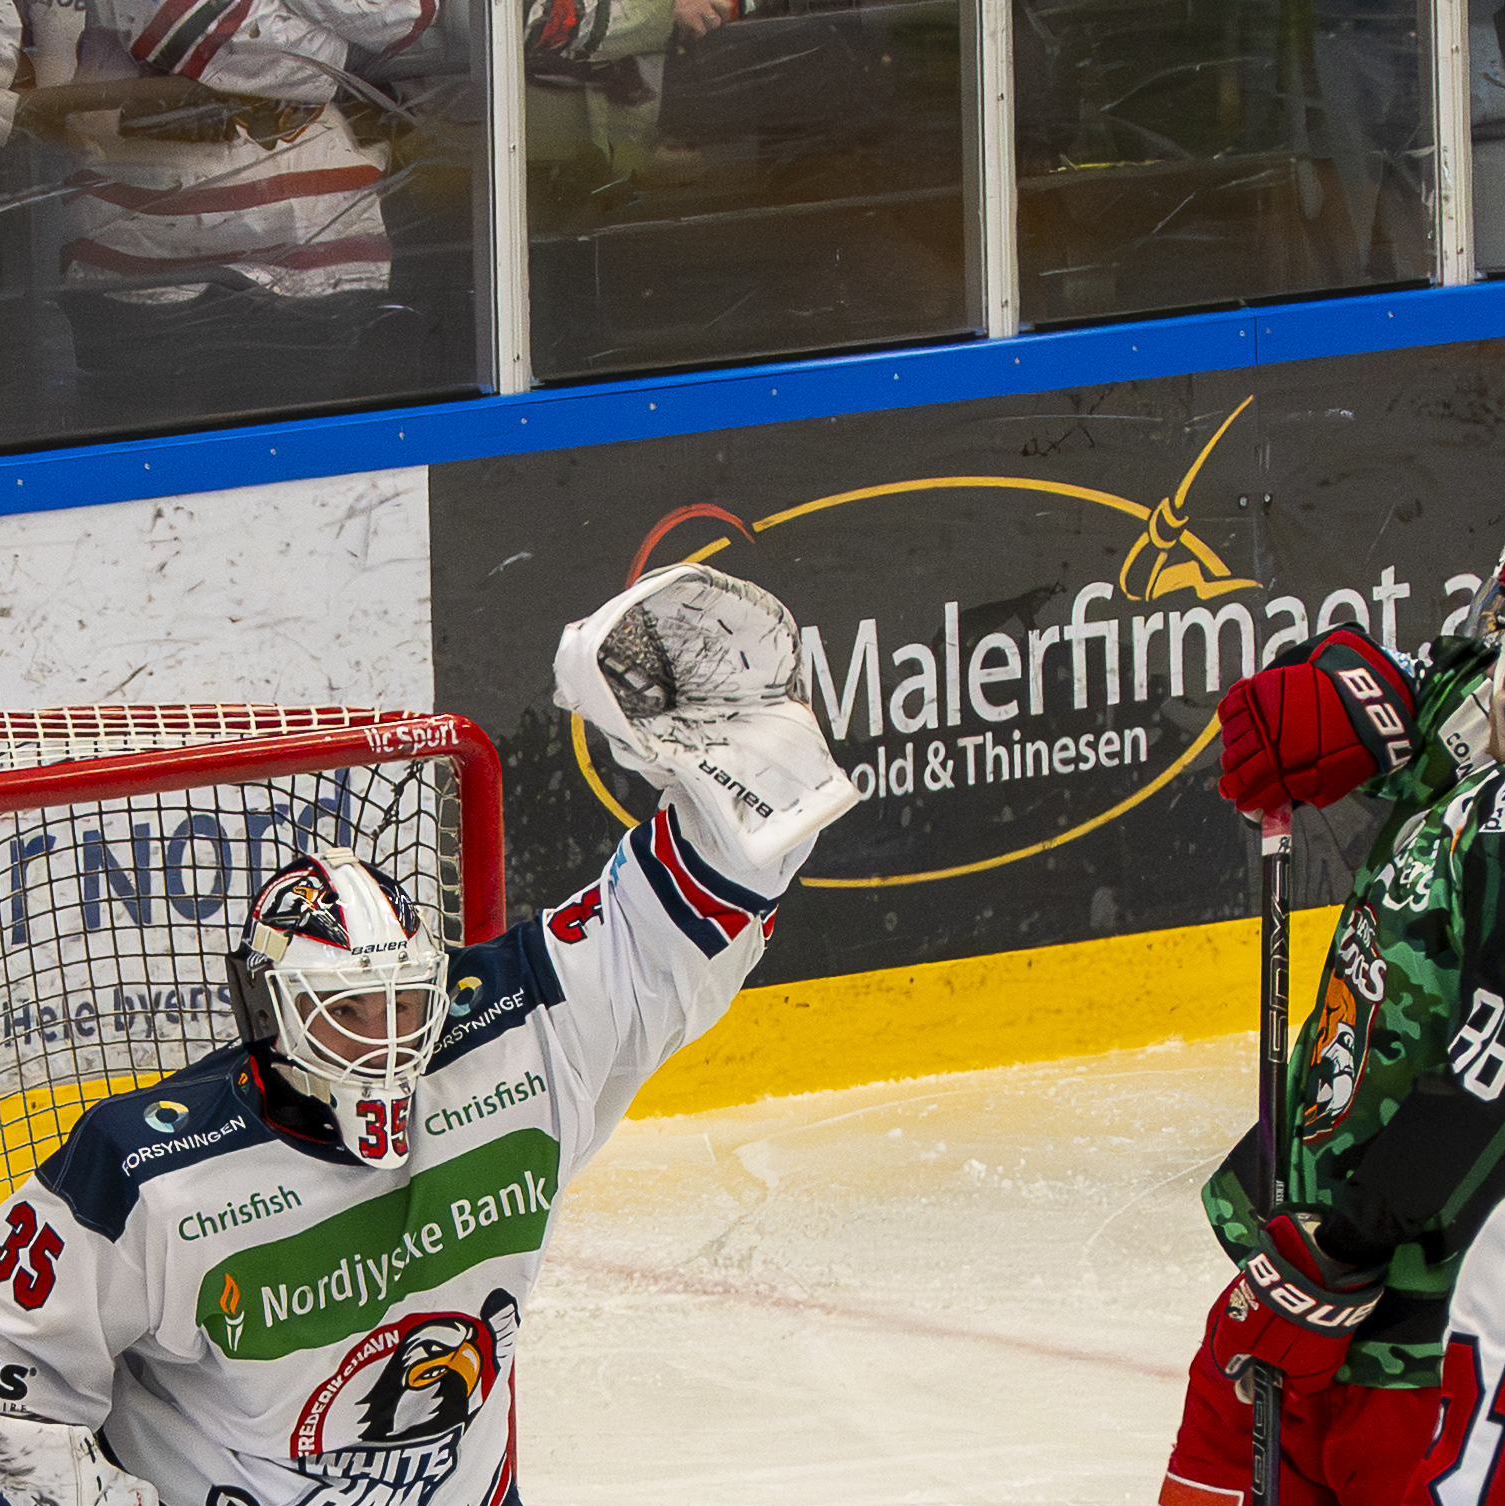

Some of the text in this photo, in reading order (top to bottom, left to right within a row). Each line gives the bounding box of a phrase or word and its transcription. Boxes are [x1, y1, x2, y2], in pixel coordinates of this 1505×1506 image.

[798, 564, 1486, 742] Malerfirmaet.a
[1337, 667, 1413, 775] BAU
[851, 720, 1148, 800] old & Thinesen
[355, 1099, 410, 1159] 35
[423, 1070, 548, 1136] Chrisfish
[121, 1115, 247, 1177] FORSYNINGEN
[177, 1184, 303, 1242] Chrisfish
[260, 1169, 551, 1329] Nordjyske Bank
